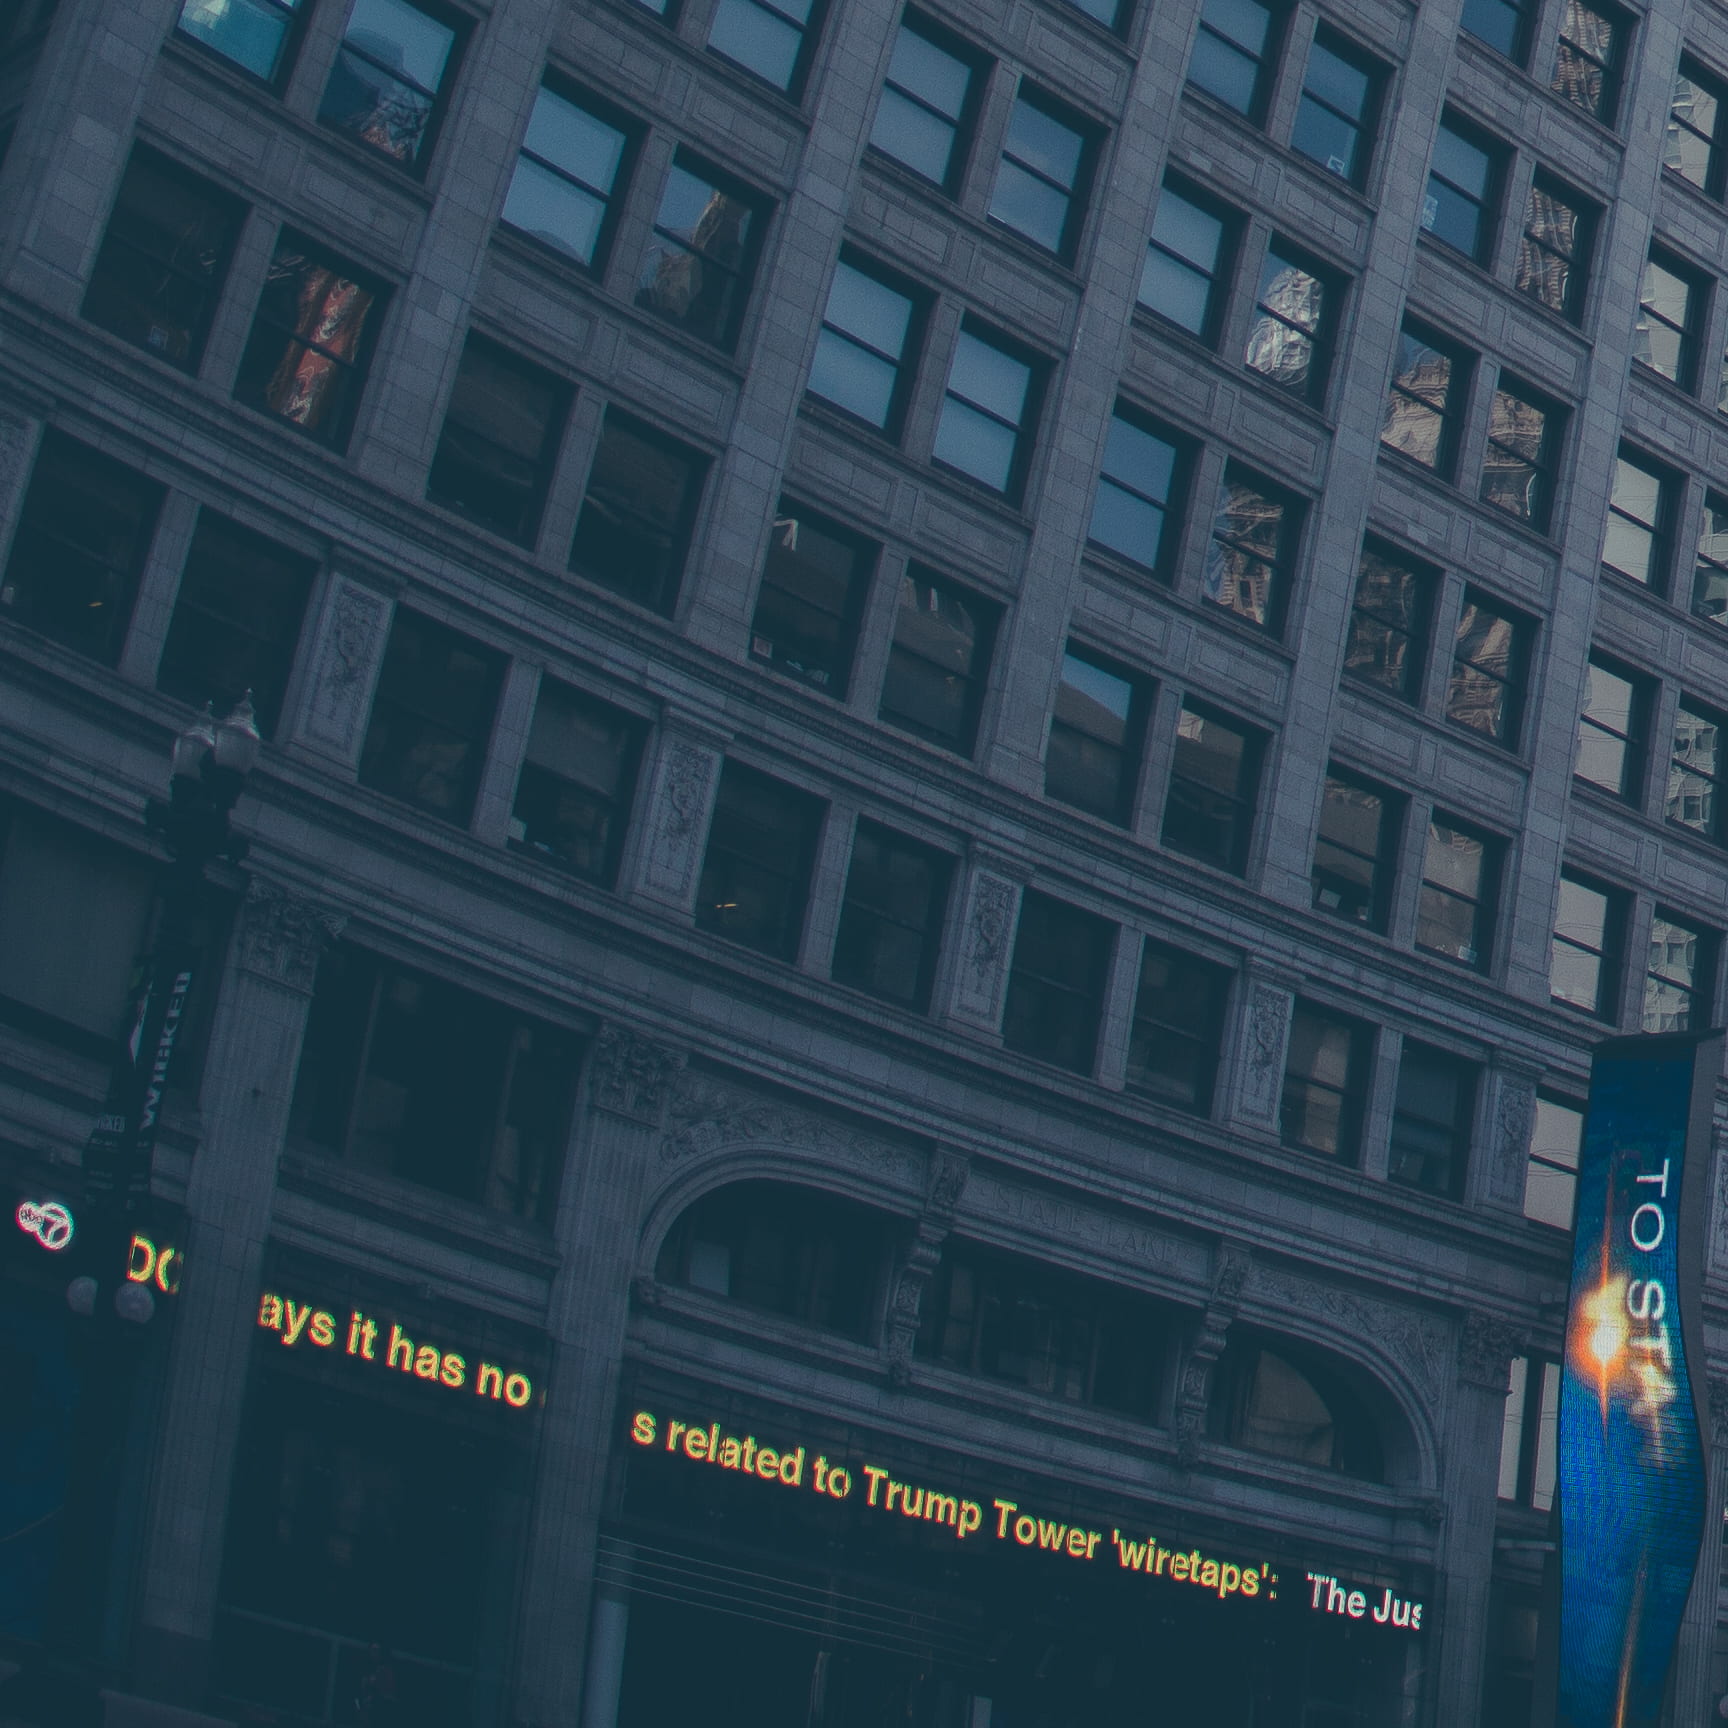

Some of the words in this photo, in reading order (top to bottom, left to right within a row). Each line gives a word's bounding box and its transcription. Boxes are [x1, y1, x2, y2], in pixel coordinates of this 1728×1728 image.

[1630, 1158, 1671, 1253] TO
[257, 1293, 336, 1346] ays
[346, 1310, 378, 1361] it
[386, 1322, 466, 1388] has
[476, 1362, 532, 1408] no
[630, 1410, 657, 1446] s
[664, 1420, 806, 1488] related
[812, 1454, 853, 1499] to
[863, 1464, 984, 1539] Trump
[993, 1498, 1103, 1560] Tower
[1112, 1528, 1279, 1601] 'wiretaps':
[1306, 1571, 1367, 1619] The
